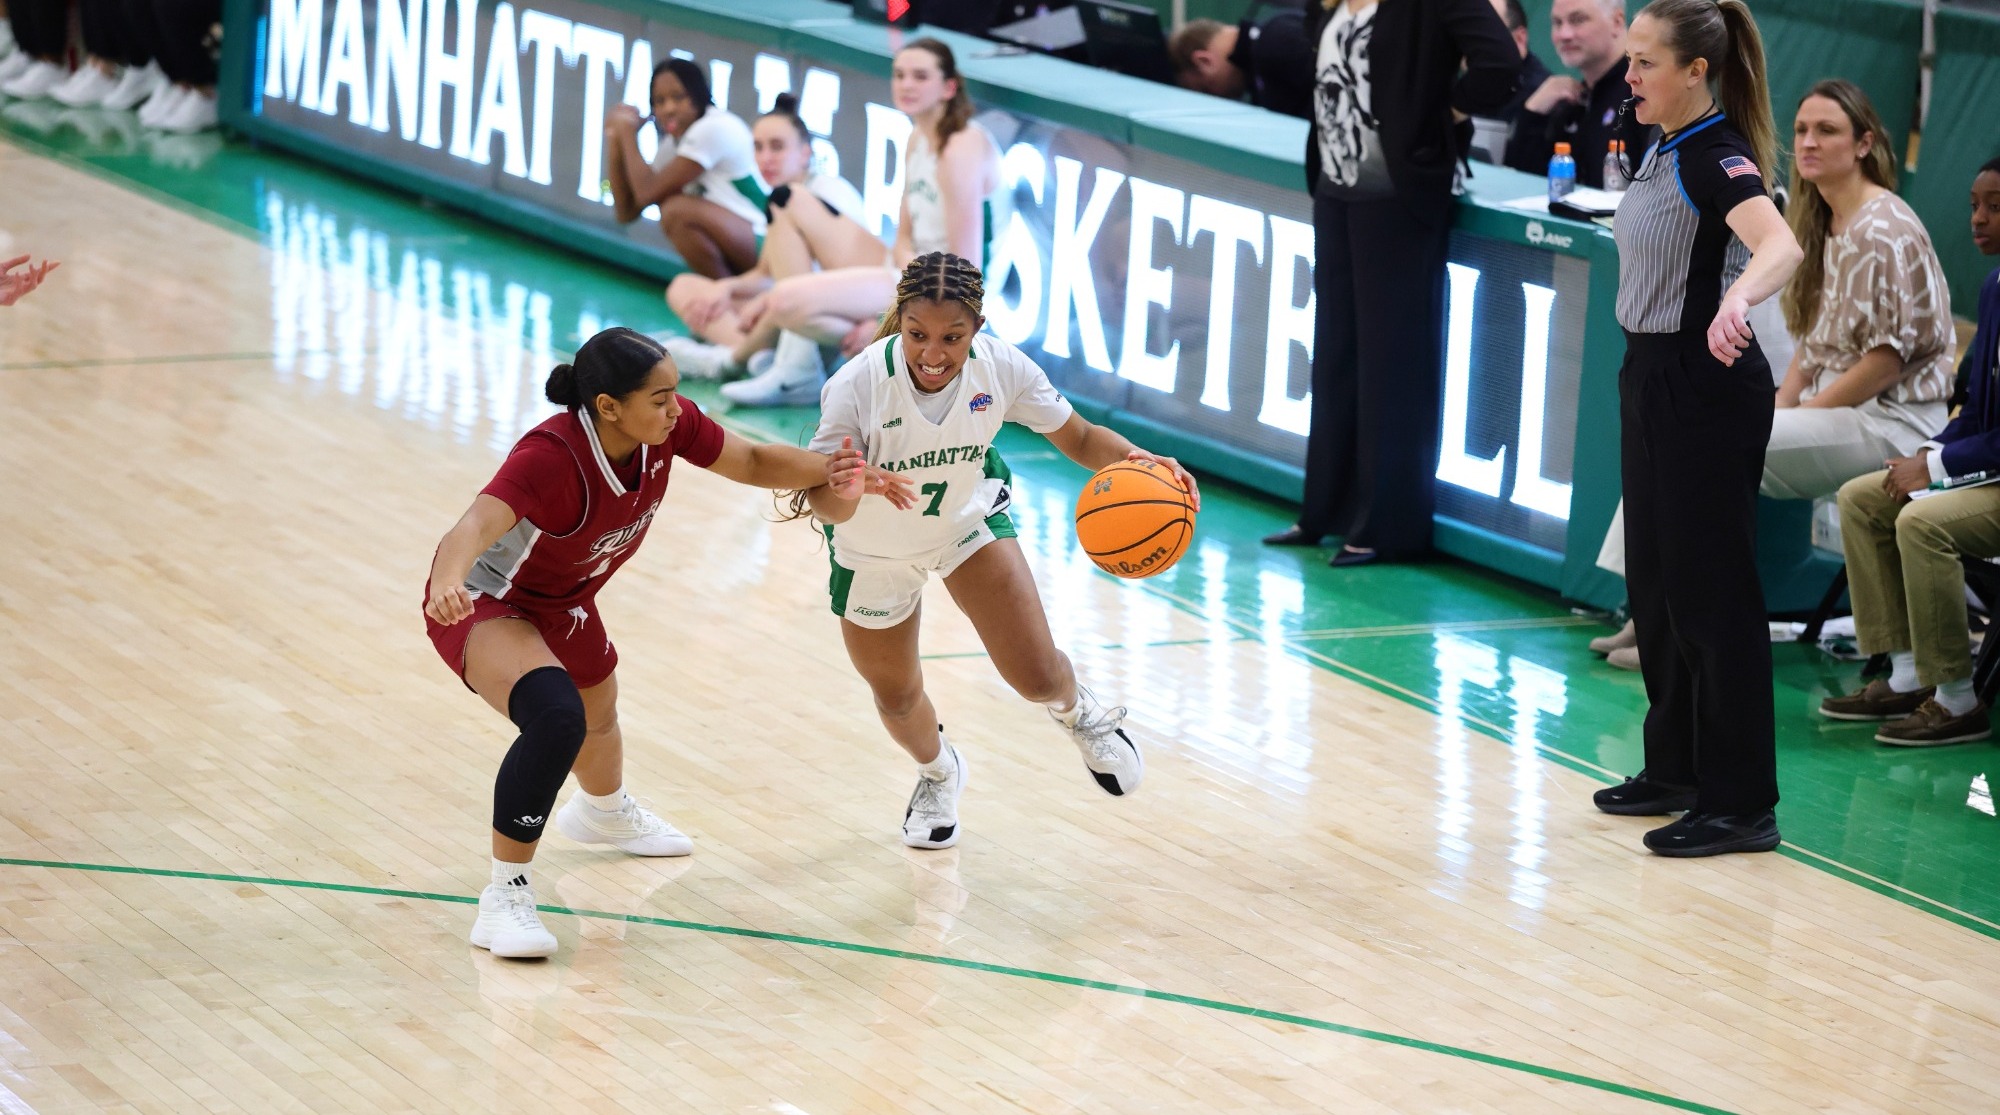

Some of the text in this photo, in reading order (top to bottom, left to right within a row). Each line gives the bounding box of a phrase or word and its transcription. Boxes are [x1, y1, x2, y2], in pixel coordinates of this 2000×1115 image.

[862, 101, 1573, 520] BSKETBLL
[921, 481, 948, 517] 7
[853, 606, 890, 617] JASPERS
